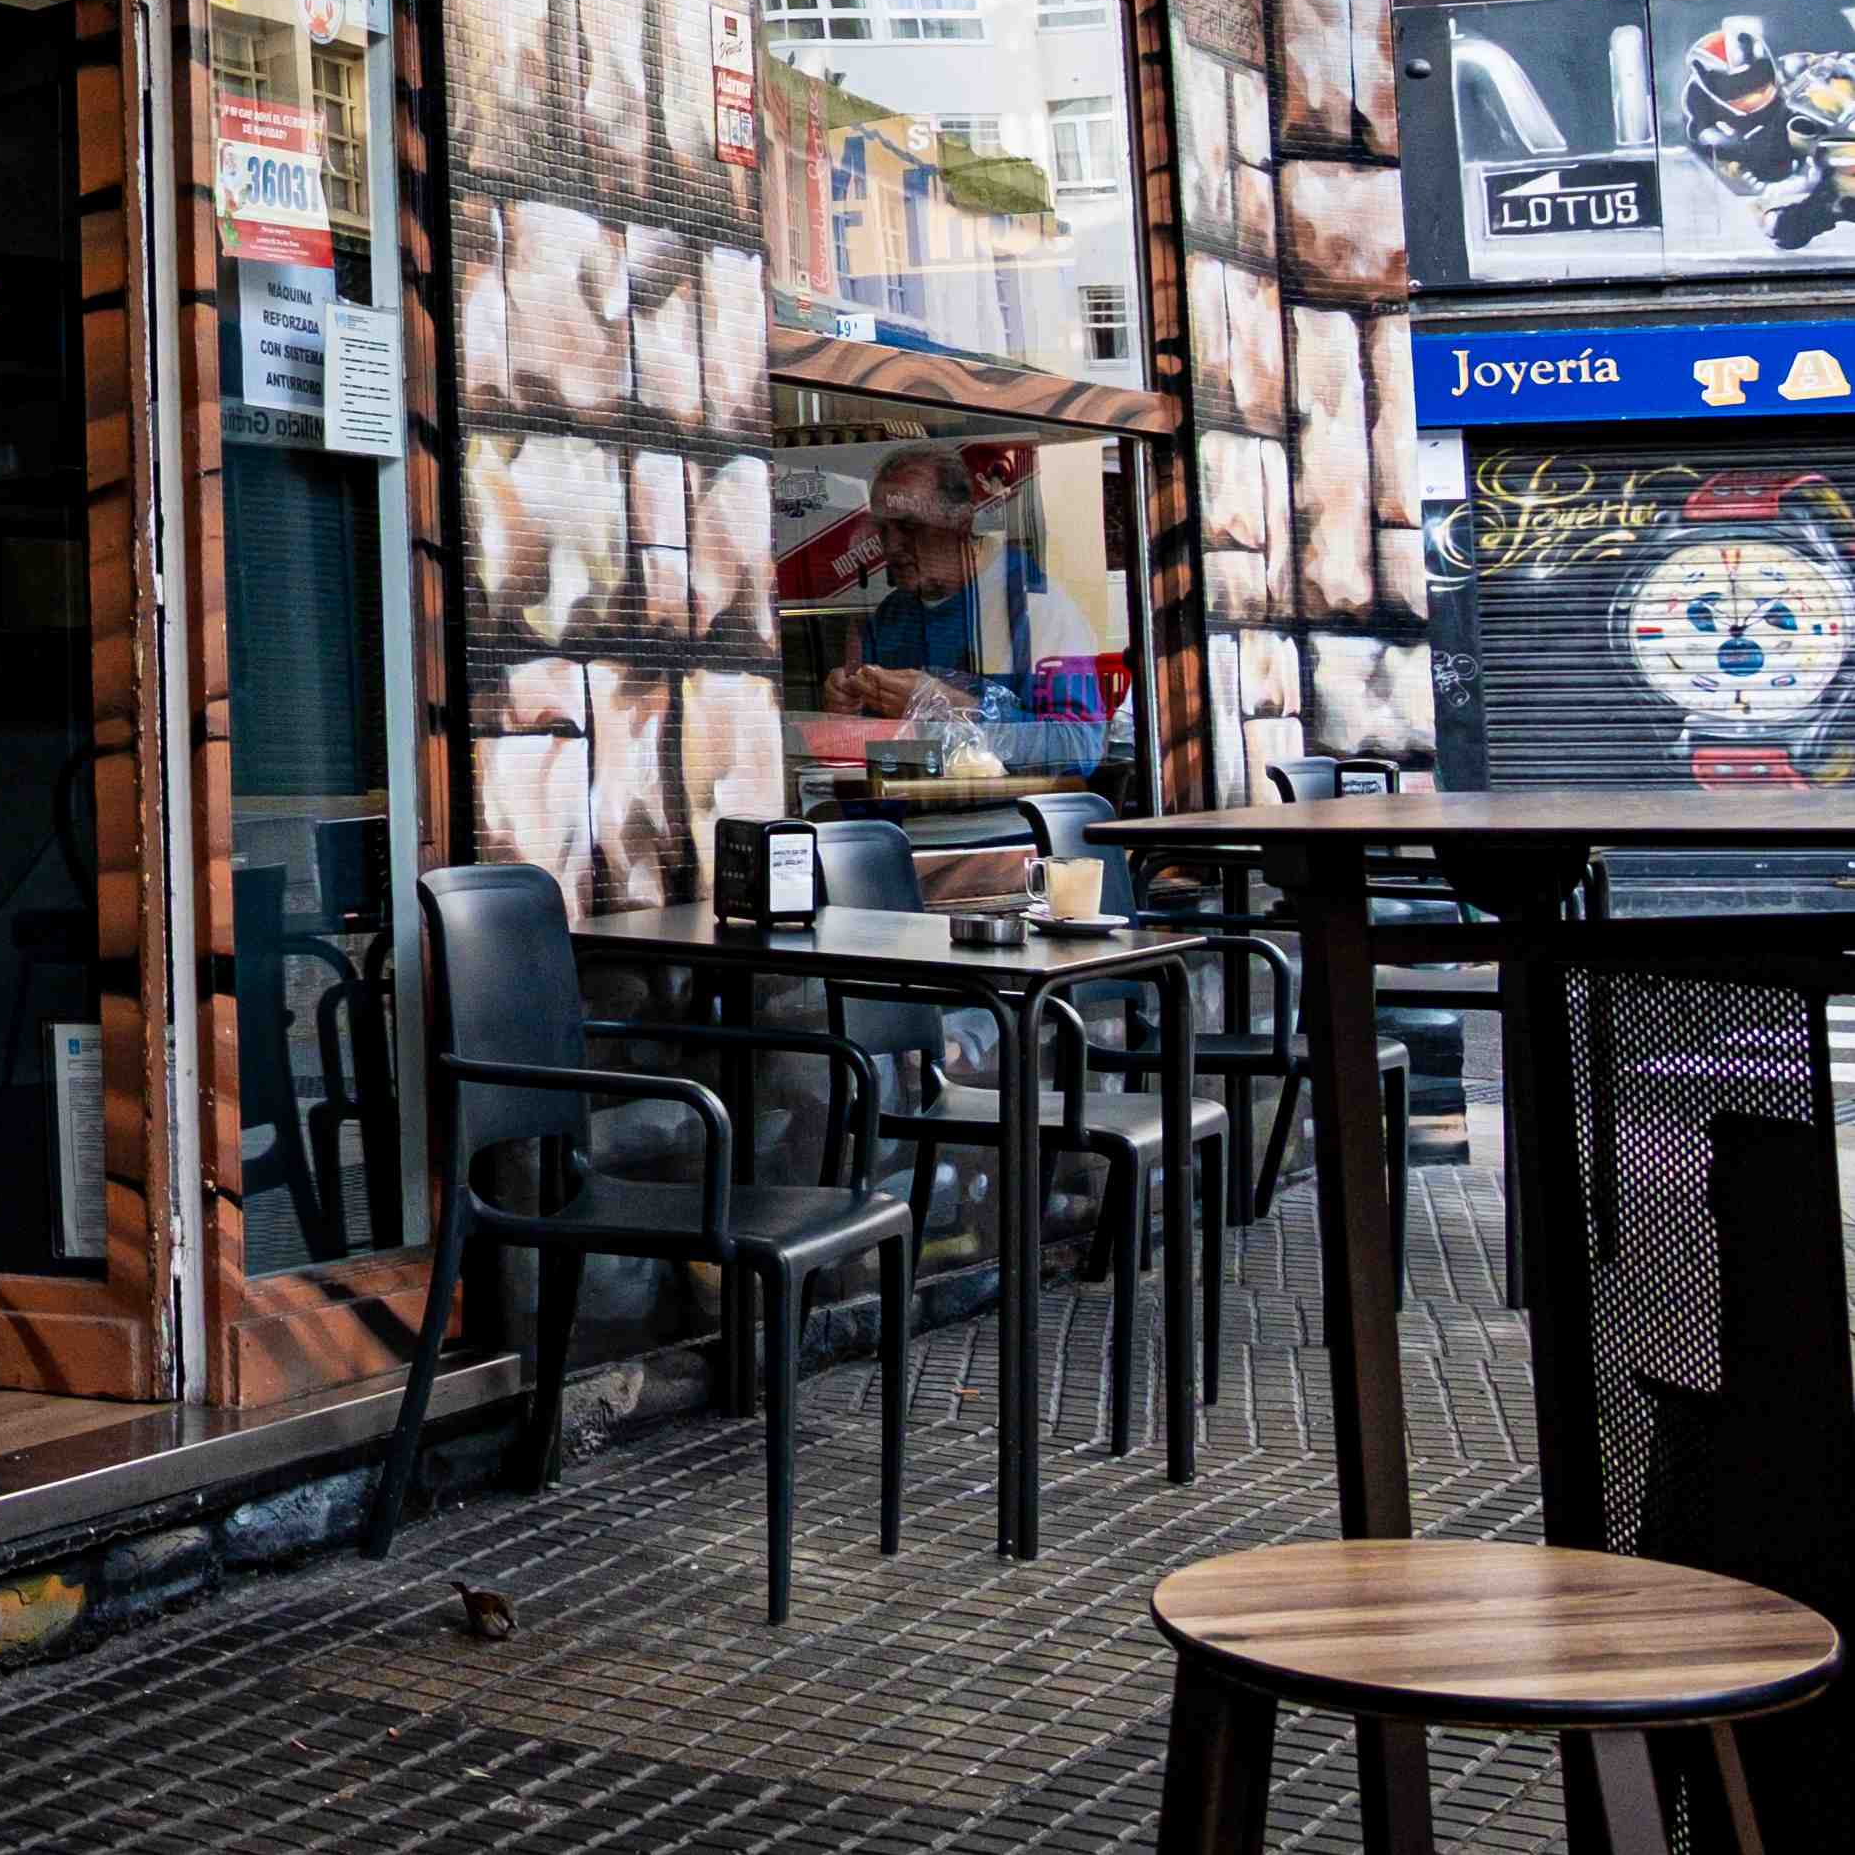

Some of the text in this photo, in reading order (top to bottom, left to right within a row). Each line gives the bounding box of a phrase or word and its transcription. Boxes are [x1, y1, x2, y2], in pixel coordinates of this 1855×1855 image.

[1501, 190, 1641, 229] LOTUS
[262, 308, 321, 337] REFORZADA
[260, 339, 324, 367] CON SISTEMA
[265, 371, 322, 395] ANTIRROBO
[1450, 348, 1622, 400] Joyería
